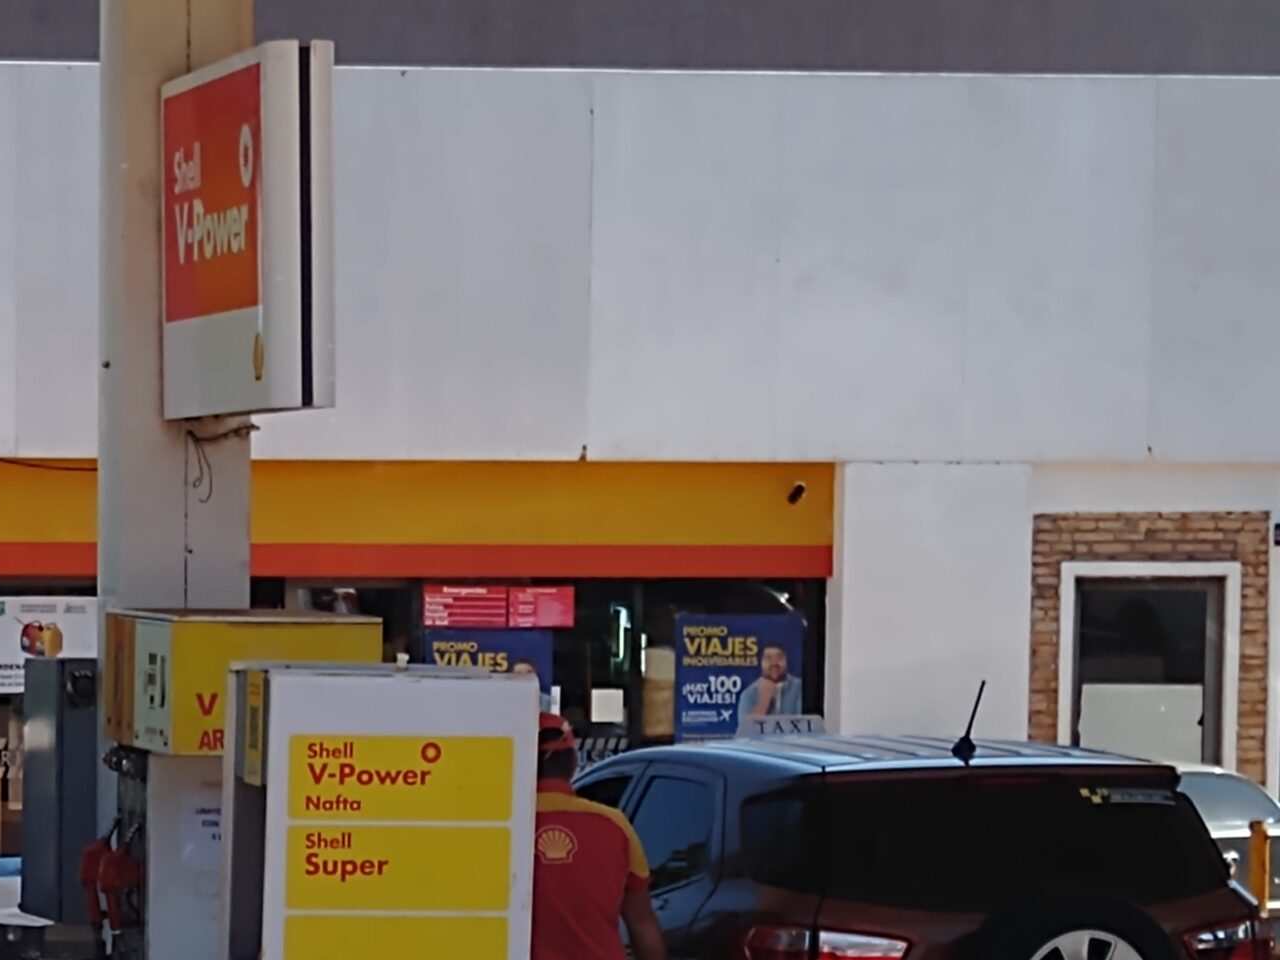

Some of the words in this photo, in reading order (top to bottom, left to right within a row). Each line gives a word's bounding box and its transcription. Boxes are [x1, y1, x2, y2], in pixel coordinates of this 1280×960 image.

[174, 142, 201, 194] Shell
[175, 198, 248, 264] V-Power
[682, 626, 728, 637] PROMO
[432, 641, 478, 653] PROMO
[683, 637, 759, 656] VIAJES
[708, 675, 742, 693] 100
[195, 692, 218, 717] V
[687, 692, 737, 705] VIAJES!
[754, 718, 813, 736] TAXI
[307, 742, 354, 759] Shell
[307, 762, 431, 786] V-Power
[305, 794, 362, 811] Nafta
[305, 832, 352, 849] Shell
[305, 852, 389, 882] Super
